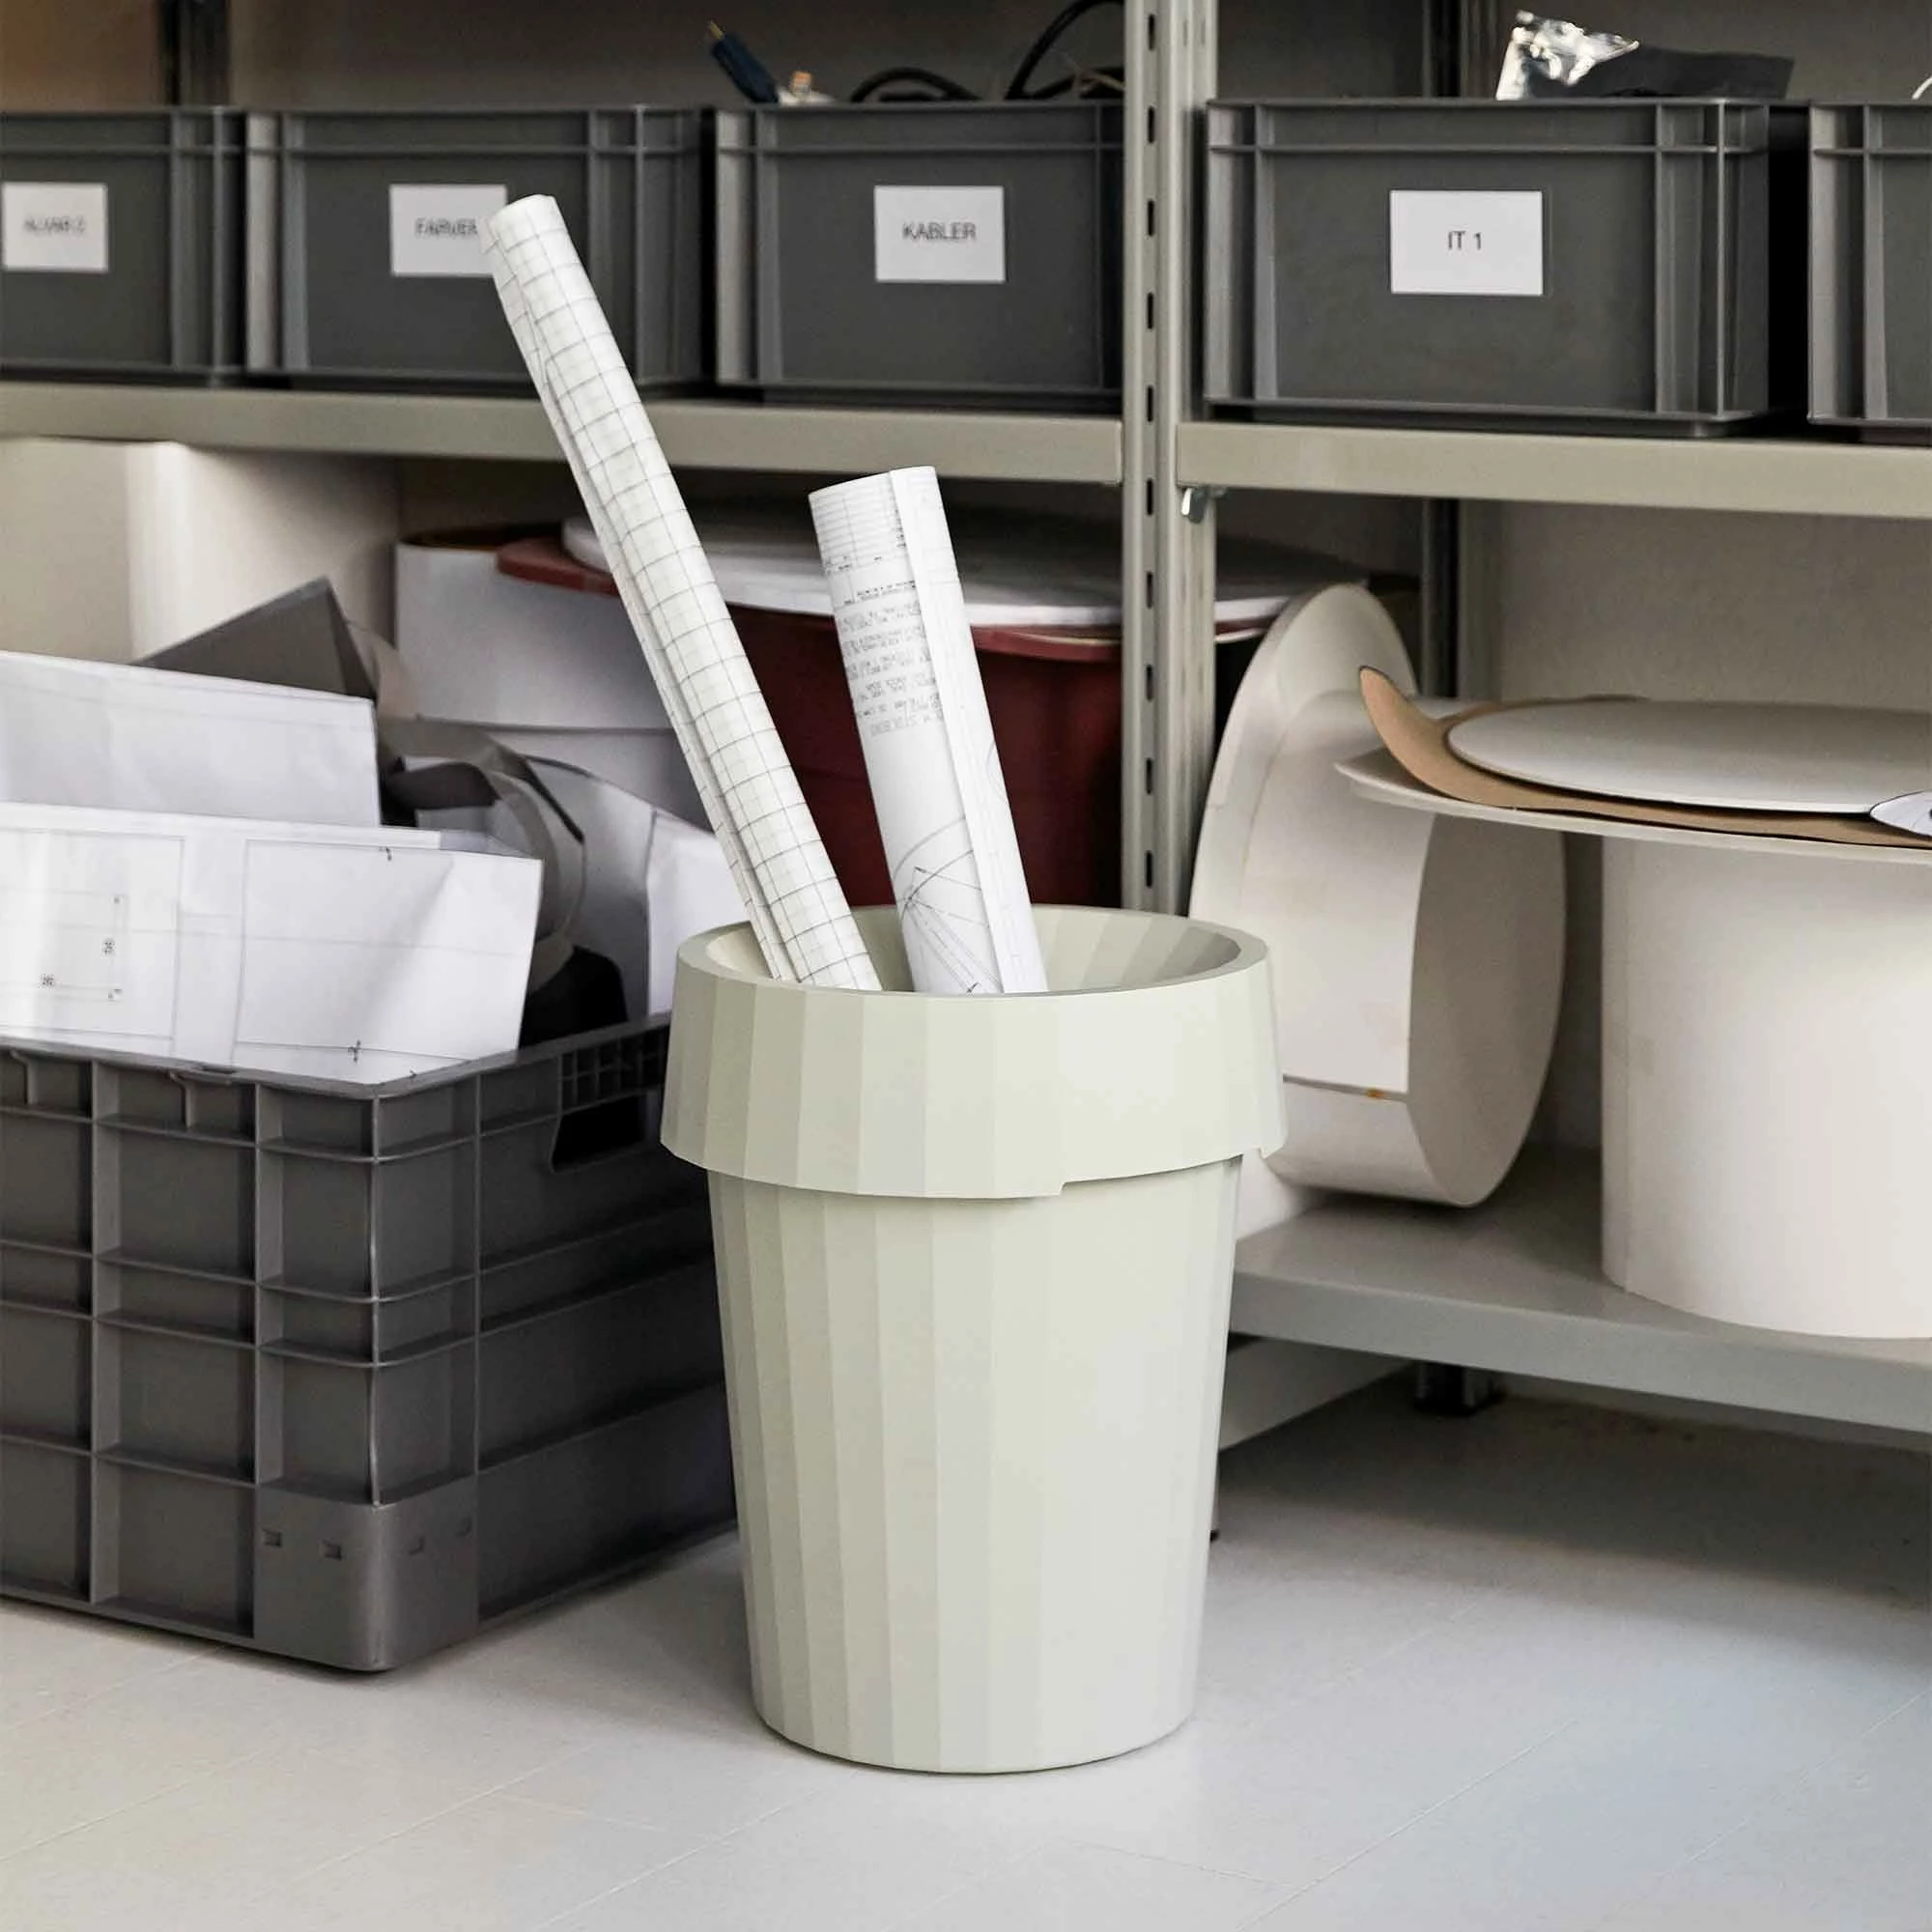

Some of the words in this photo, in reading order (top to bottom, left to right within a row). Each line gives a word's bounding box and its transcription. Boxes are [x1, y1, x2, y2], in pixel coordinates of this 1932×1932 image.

[902, 221, 977, 241] KABLER
[1448, 230, 1466, 250] IT
[1473, 231, 1482, 250] 1
